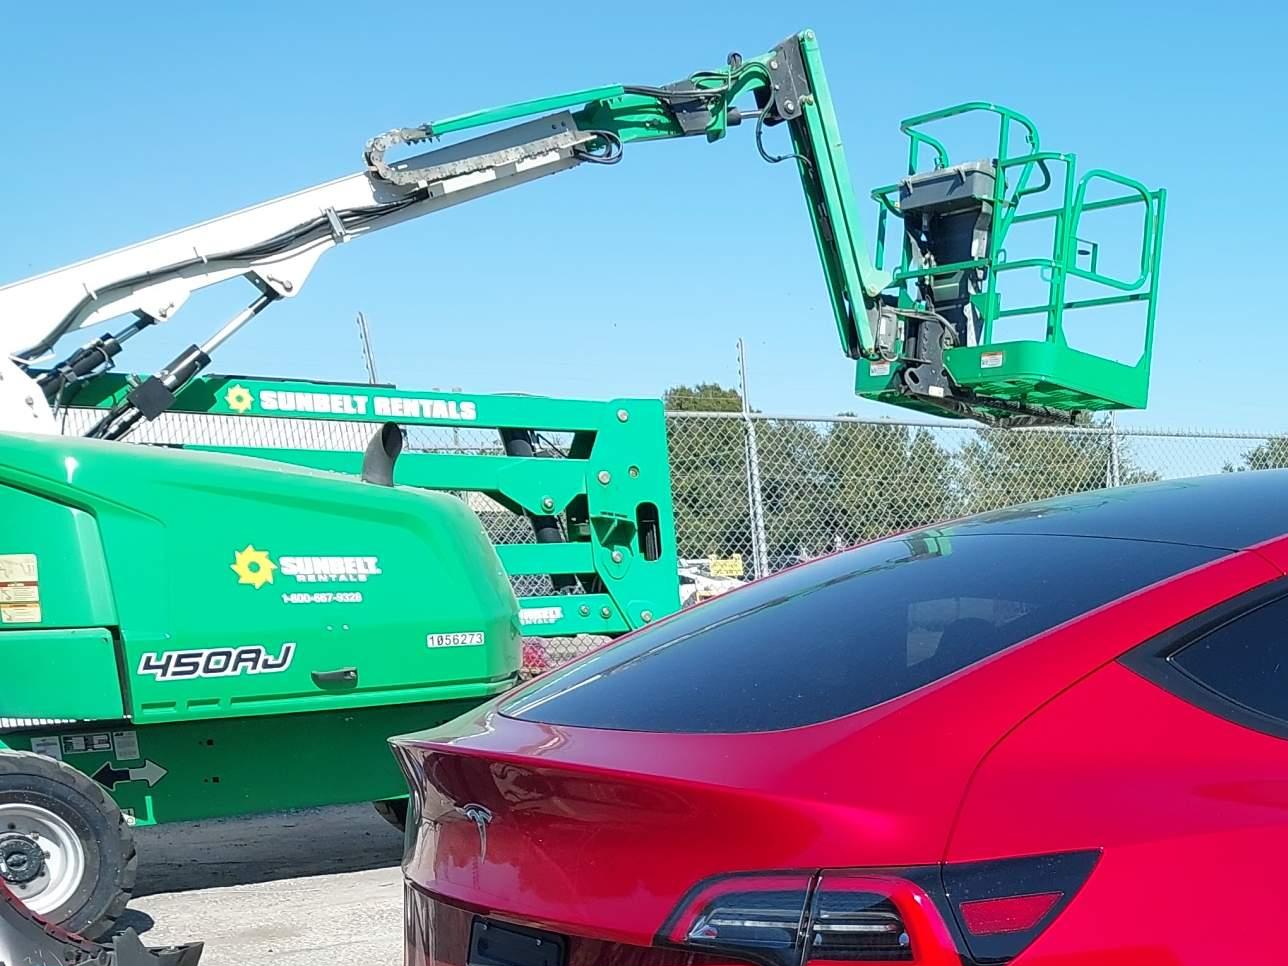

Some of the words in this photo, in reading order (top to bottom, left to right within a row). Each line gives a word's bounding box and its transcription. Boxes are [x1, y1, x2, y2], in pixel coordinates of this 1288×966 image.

[259, 390, 368, 415] SUNBELT
[373, 396, 477, 420] RENTALS
[279, 556, 380, 575] SUNBELT
[296, 574, 368, 583] RENTALS
[428, 632, 483, 647] 1056273
[139, 643, 295, 680] 450AJ
